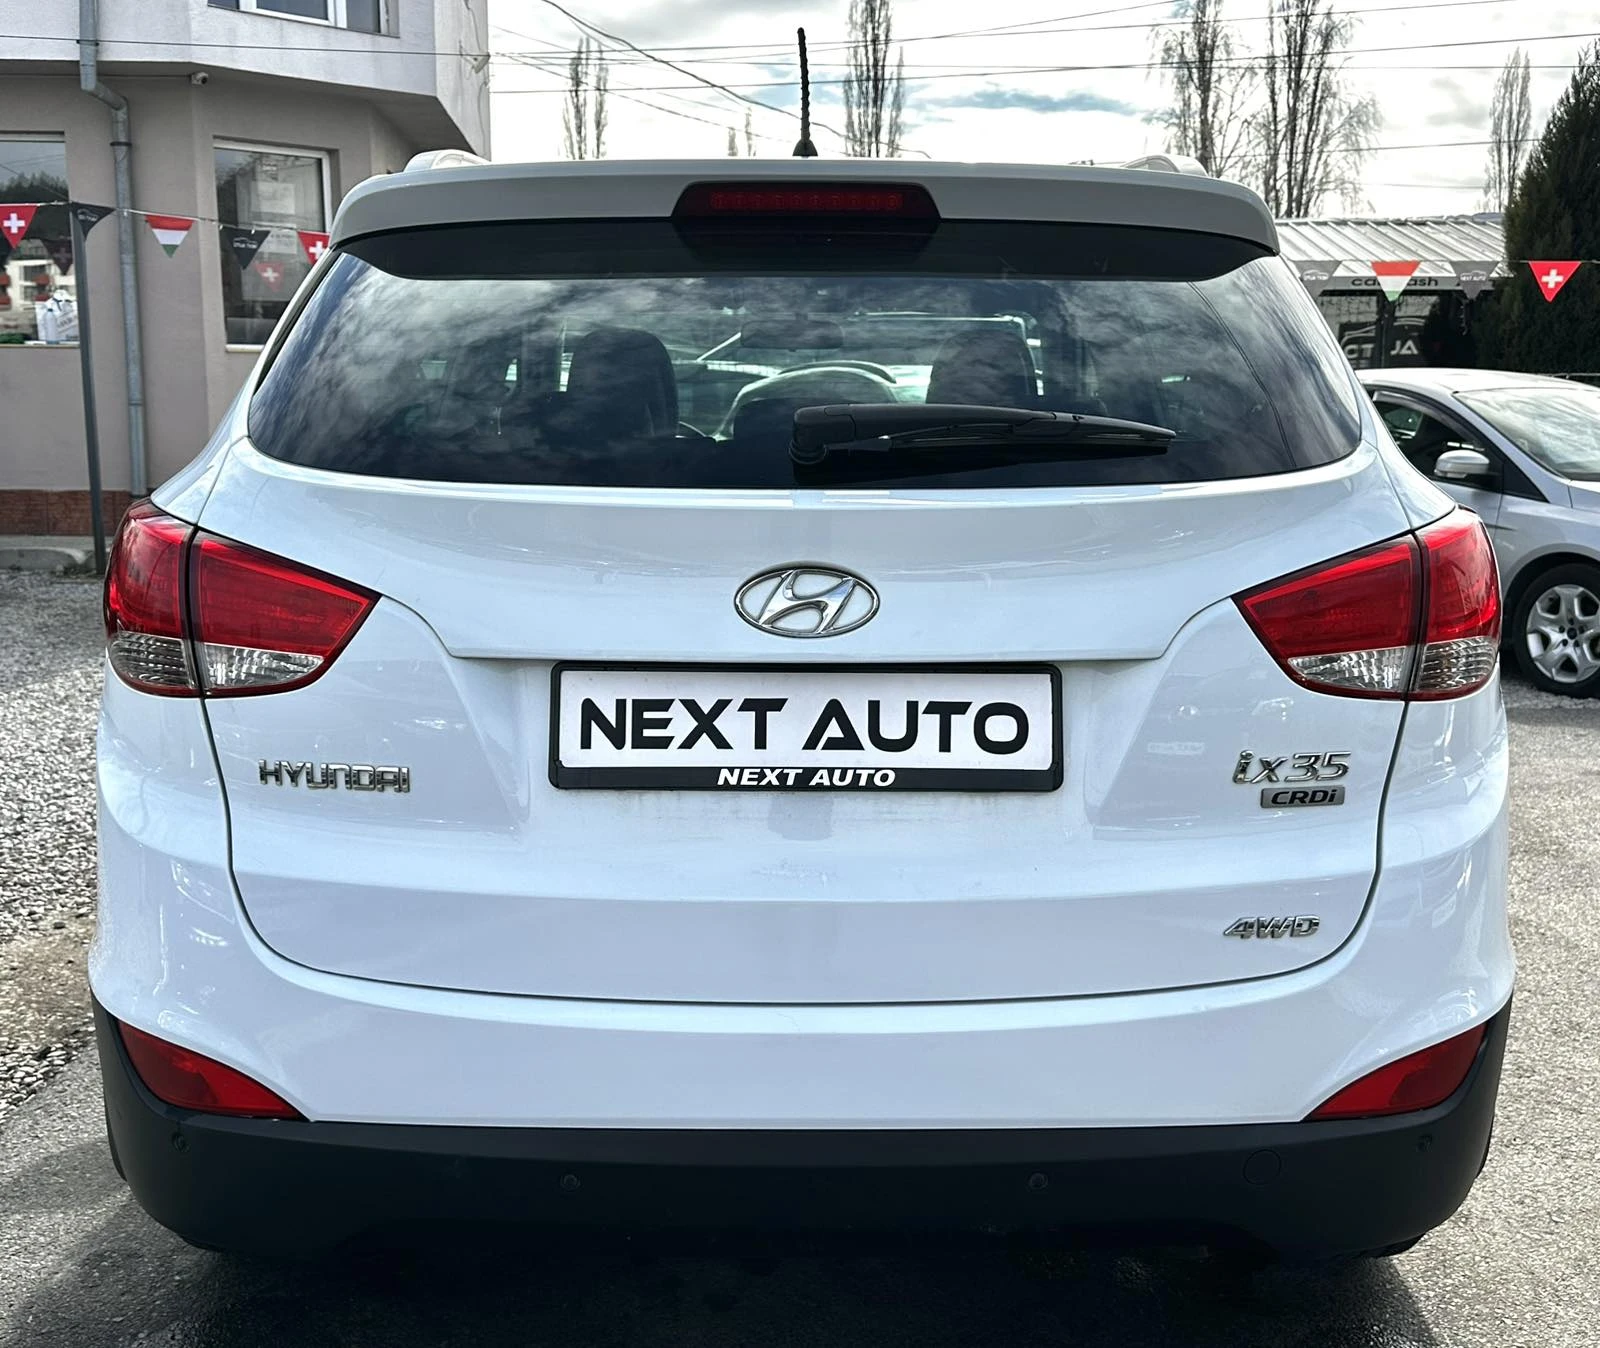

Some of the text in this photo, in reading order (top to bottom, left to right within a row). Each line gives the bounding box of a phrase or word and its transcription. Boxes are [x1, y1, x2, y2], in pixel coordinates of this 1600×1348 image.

[1406, 276, 1439, 287] ash
[580, 697, 1030, 755] NEXT AUTO
[258, 758, 411, 793] HYUNDAI
[716, 768, 897, 787] NEXT AUTO
[1232, 749, 1352, 784] ix35
[1271, 788, 1338, 805] CRDi
[1223, 914, 1320, 940] 4WD
